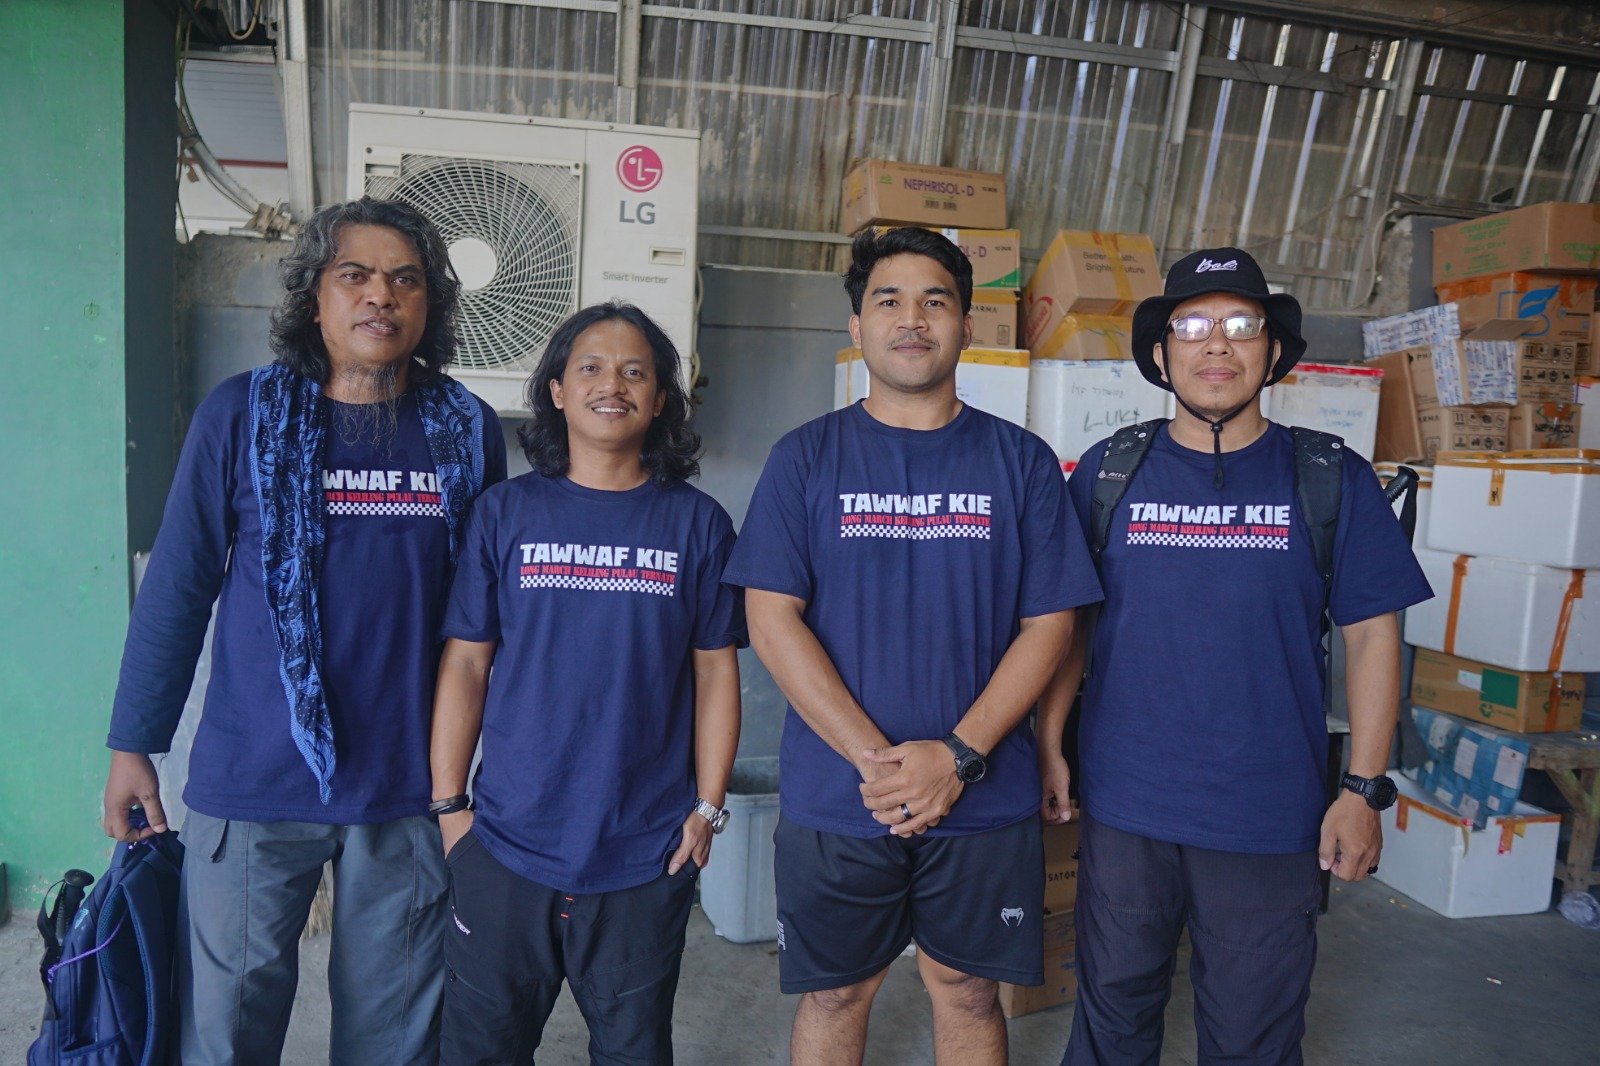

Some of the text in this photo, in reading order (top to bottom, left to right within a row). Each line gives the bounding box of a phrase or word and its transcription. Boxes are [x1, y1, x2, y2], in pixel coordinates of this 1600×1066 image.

[619, 200, 656, 225] LG
[602, 271, 669, 284] Smart Inverter
[346, 492, 384, 502] KELILING
[386, 492, 413, 502] PULAU
[839, 493, 992, 516] TAWWAF KIE
[840, 515, 862, 525] LONG
[864, 515, 892, 525] MARCH
[927, 515, 950, 525] PULAU
[953, 515, 990, 526] TERNATE
[1129, 503, 1290, 526] TAWWAF KIE
[1128, 523, 1289, 537] LONG MARCH KELILING PULAU TERNATE
[520, 543, 678, 573] TAWWAF KIE
[520, 565, 675, 583] LONG MARCH KELILING PULAU TERNATE
